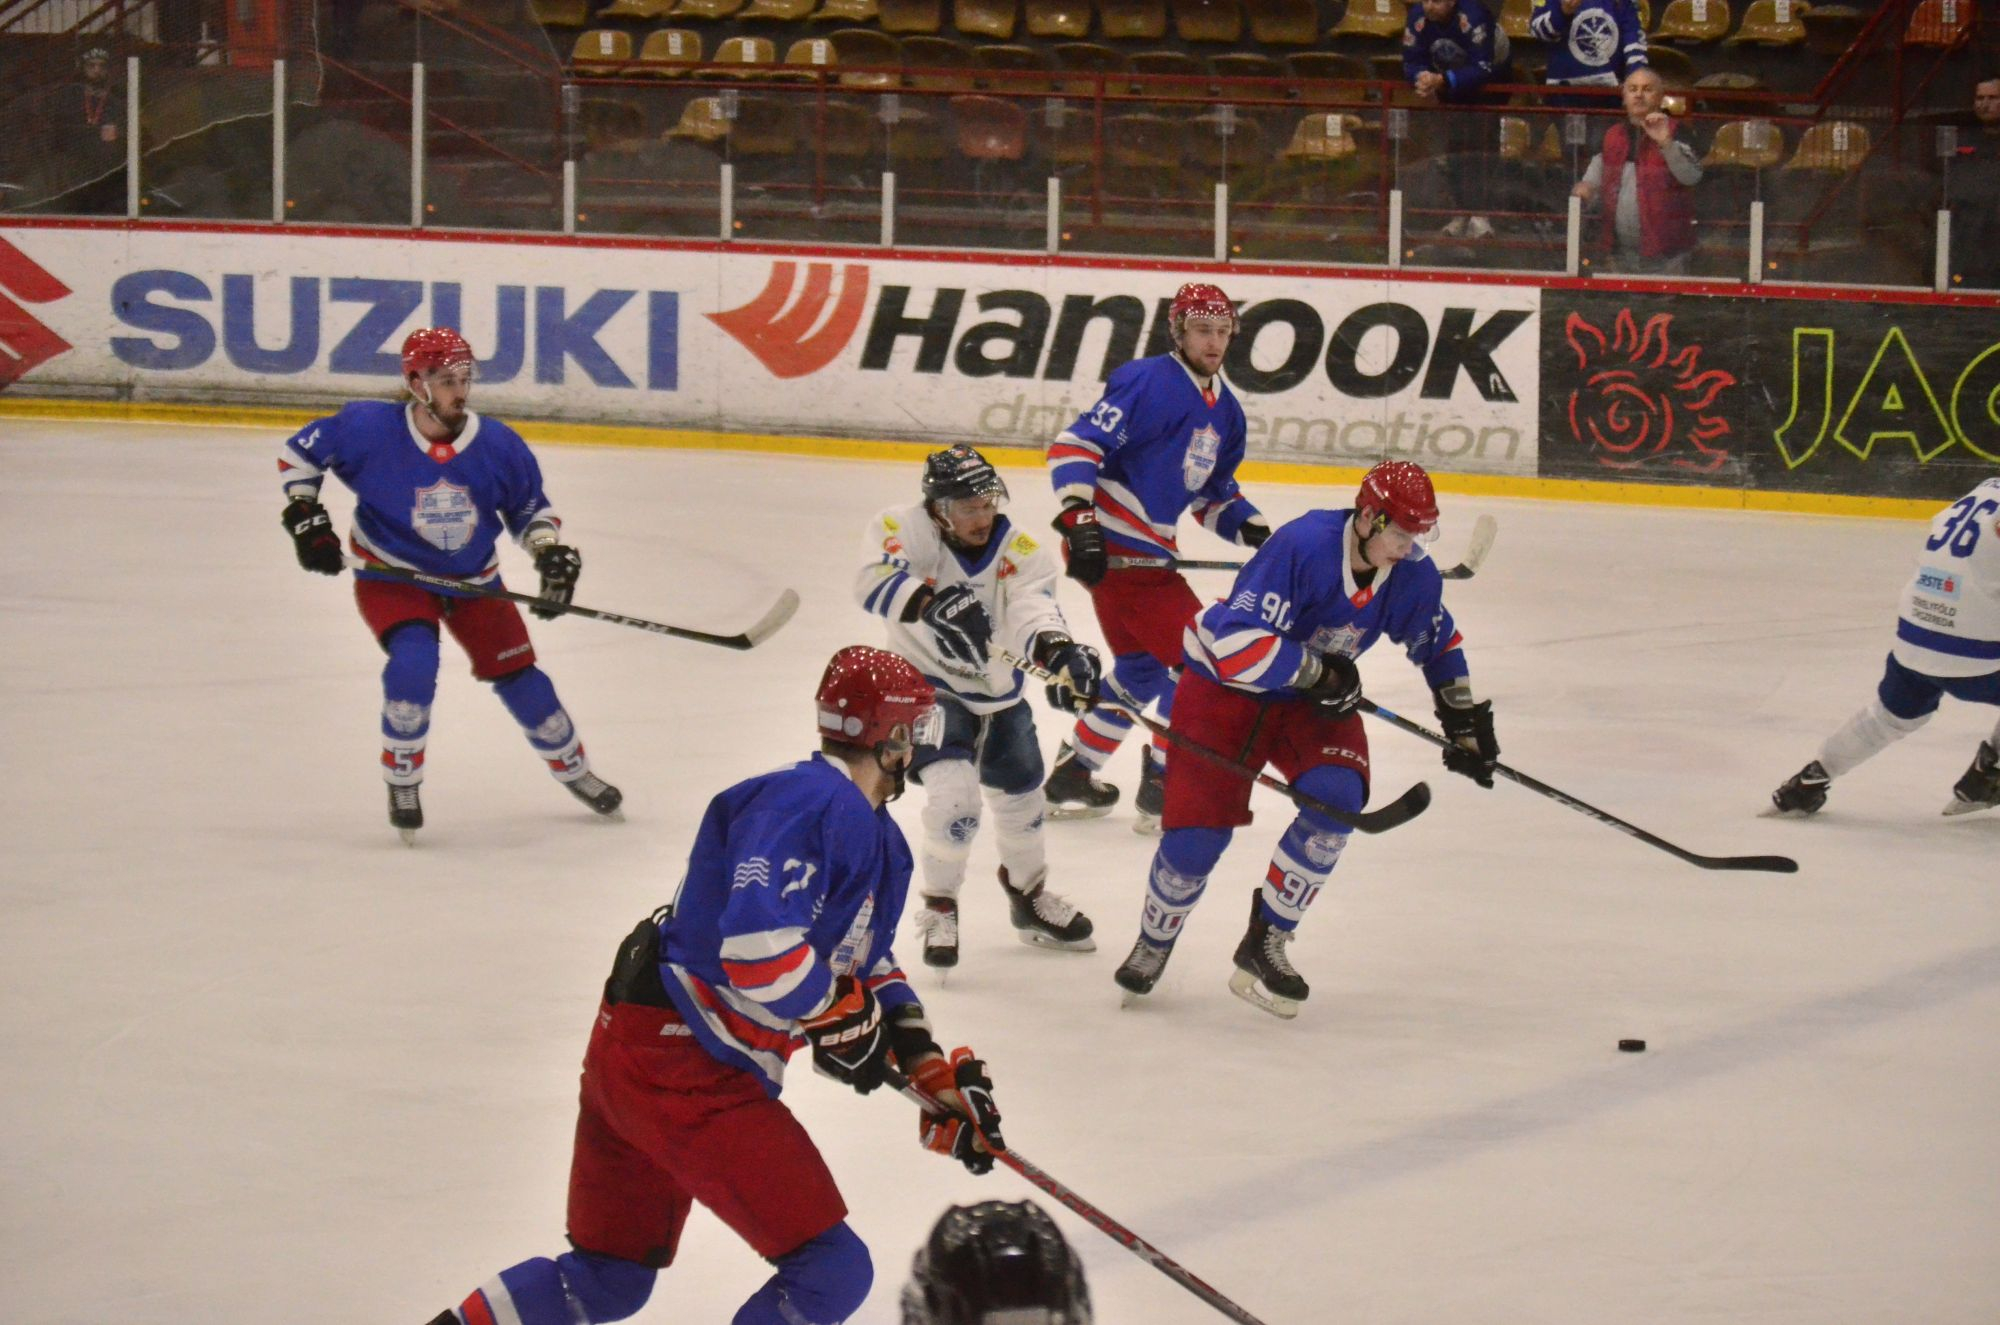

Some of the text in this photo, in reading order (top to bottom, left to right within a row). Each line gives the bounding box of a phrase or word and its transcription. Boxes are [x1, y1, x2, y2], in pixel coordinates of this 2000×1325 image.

[110, 269, 679, 391] SUZUKI
[1090, 401, 1123, 433] 33
[1926, 496, 1999, 558] 36
[393, 747, 414, 776] 5
[559, 749, 584, 775] 5
[1322, 746, 1368, 767] CCM
[1276, 870, 1326, 909] 90
[1144, 902, 1188, 932] 90
